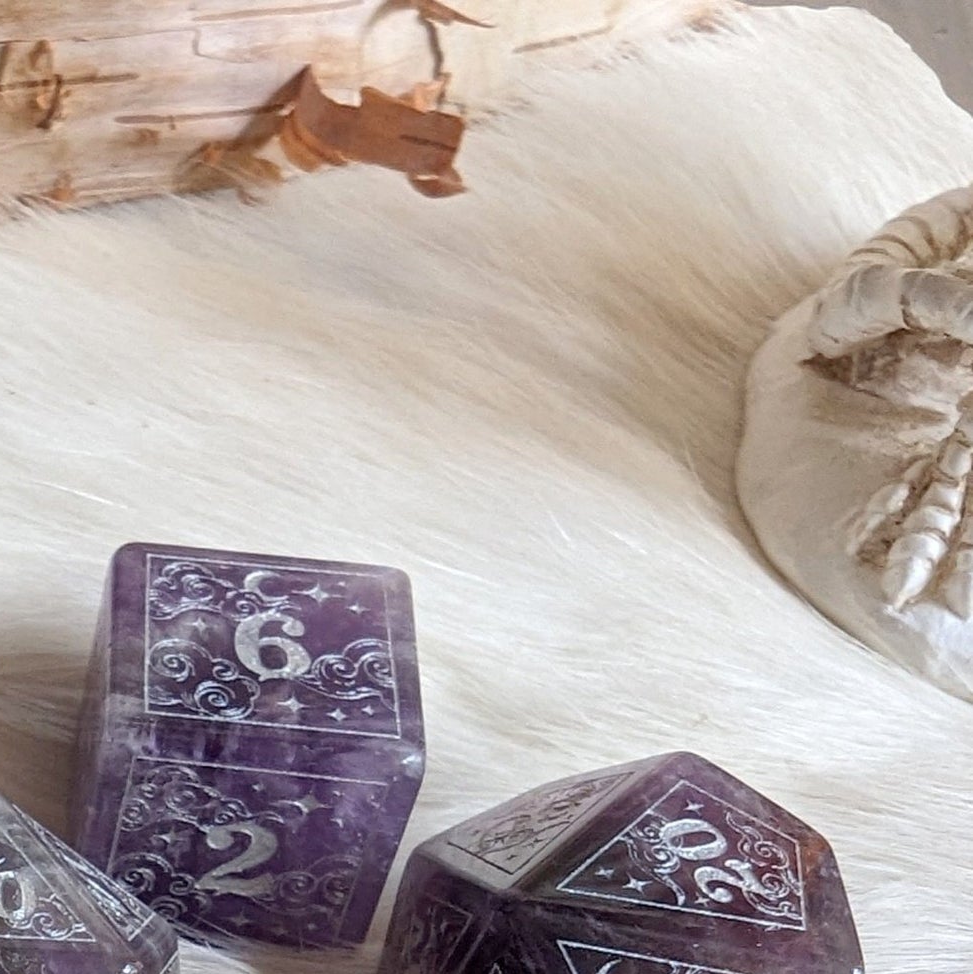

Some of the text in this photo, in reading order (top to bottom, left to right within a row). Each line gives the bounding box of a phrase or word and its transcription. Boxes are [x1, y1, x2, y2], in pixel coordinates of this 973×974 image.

[234, 611, 312, 681] 6
[195, 821, 279, 896] 2
[660, 818, 772, 904] 20
